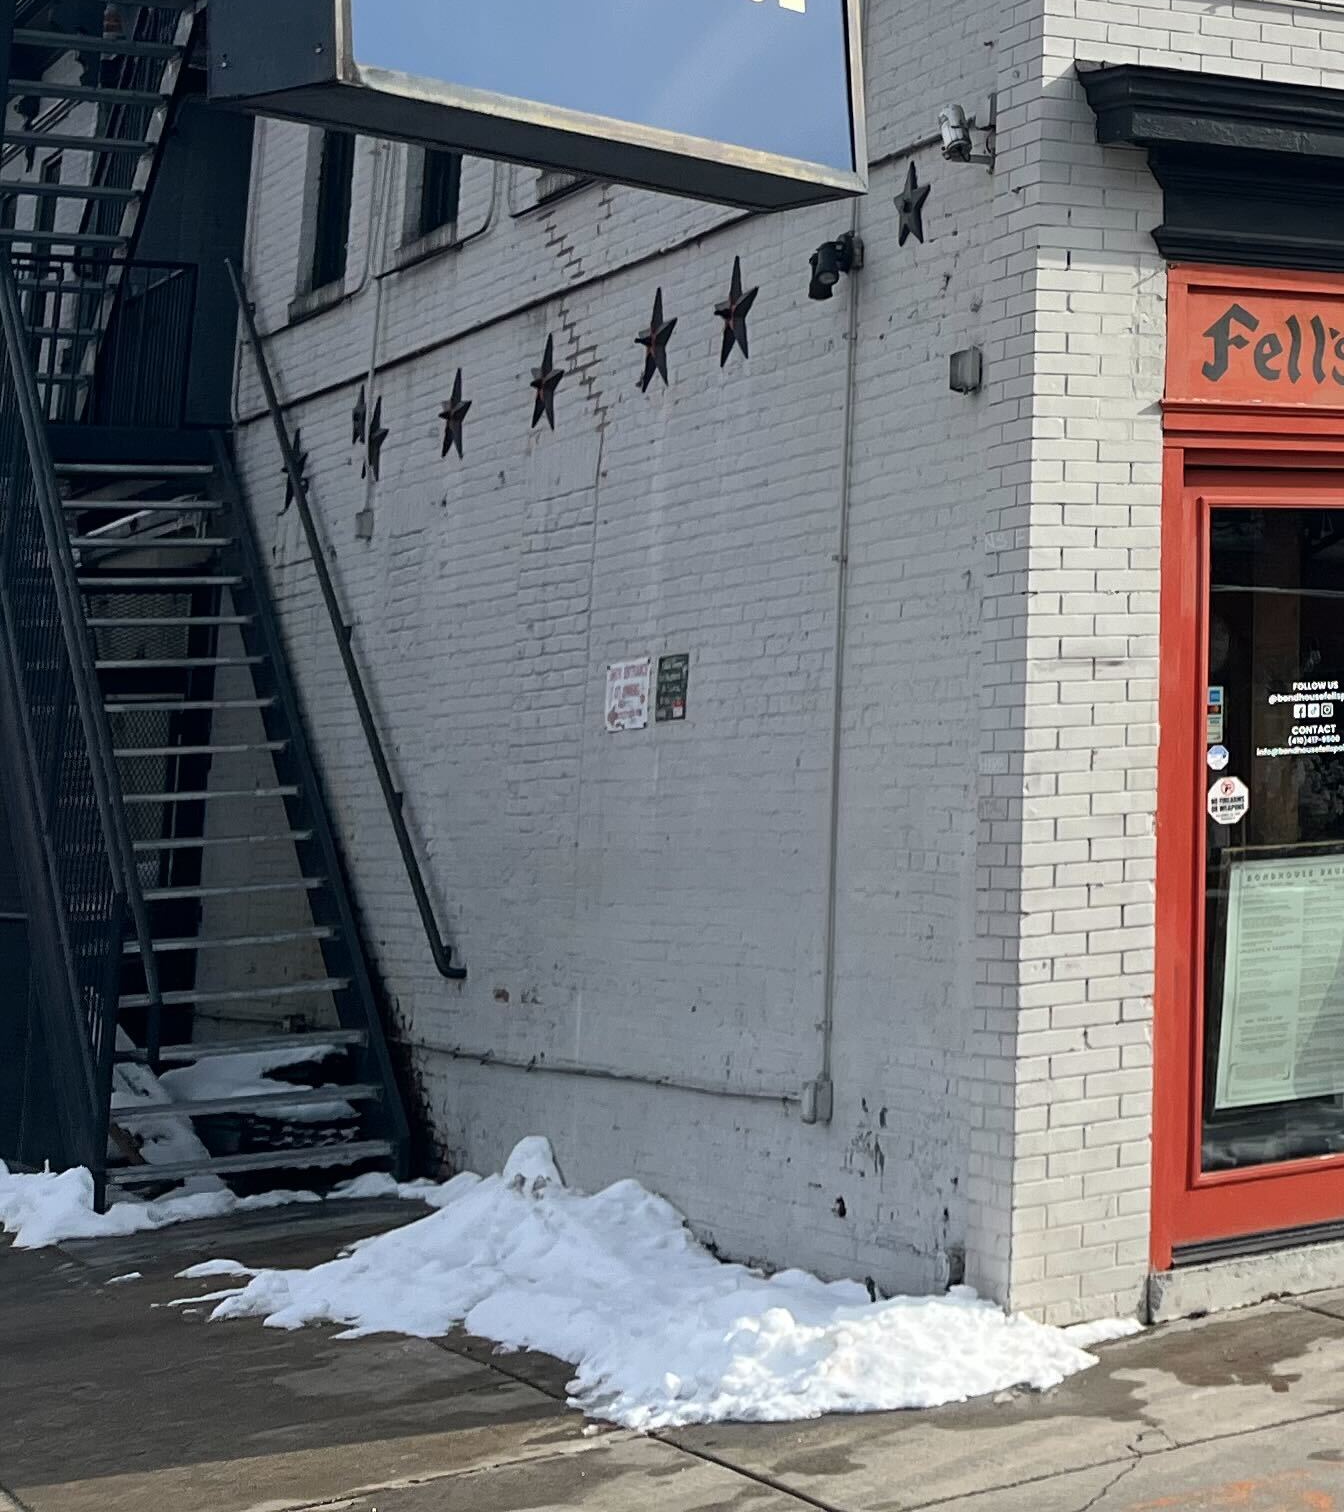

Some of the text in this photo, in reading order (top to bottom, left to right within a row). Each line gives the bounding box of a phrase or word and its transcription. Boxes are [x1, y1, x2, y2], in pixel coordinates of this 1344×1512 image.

[1292, 680, 1339, 691] FOLLOW US
[1291, 724, 1337, 735] CONTACT
